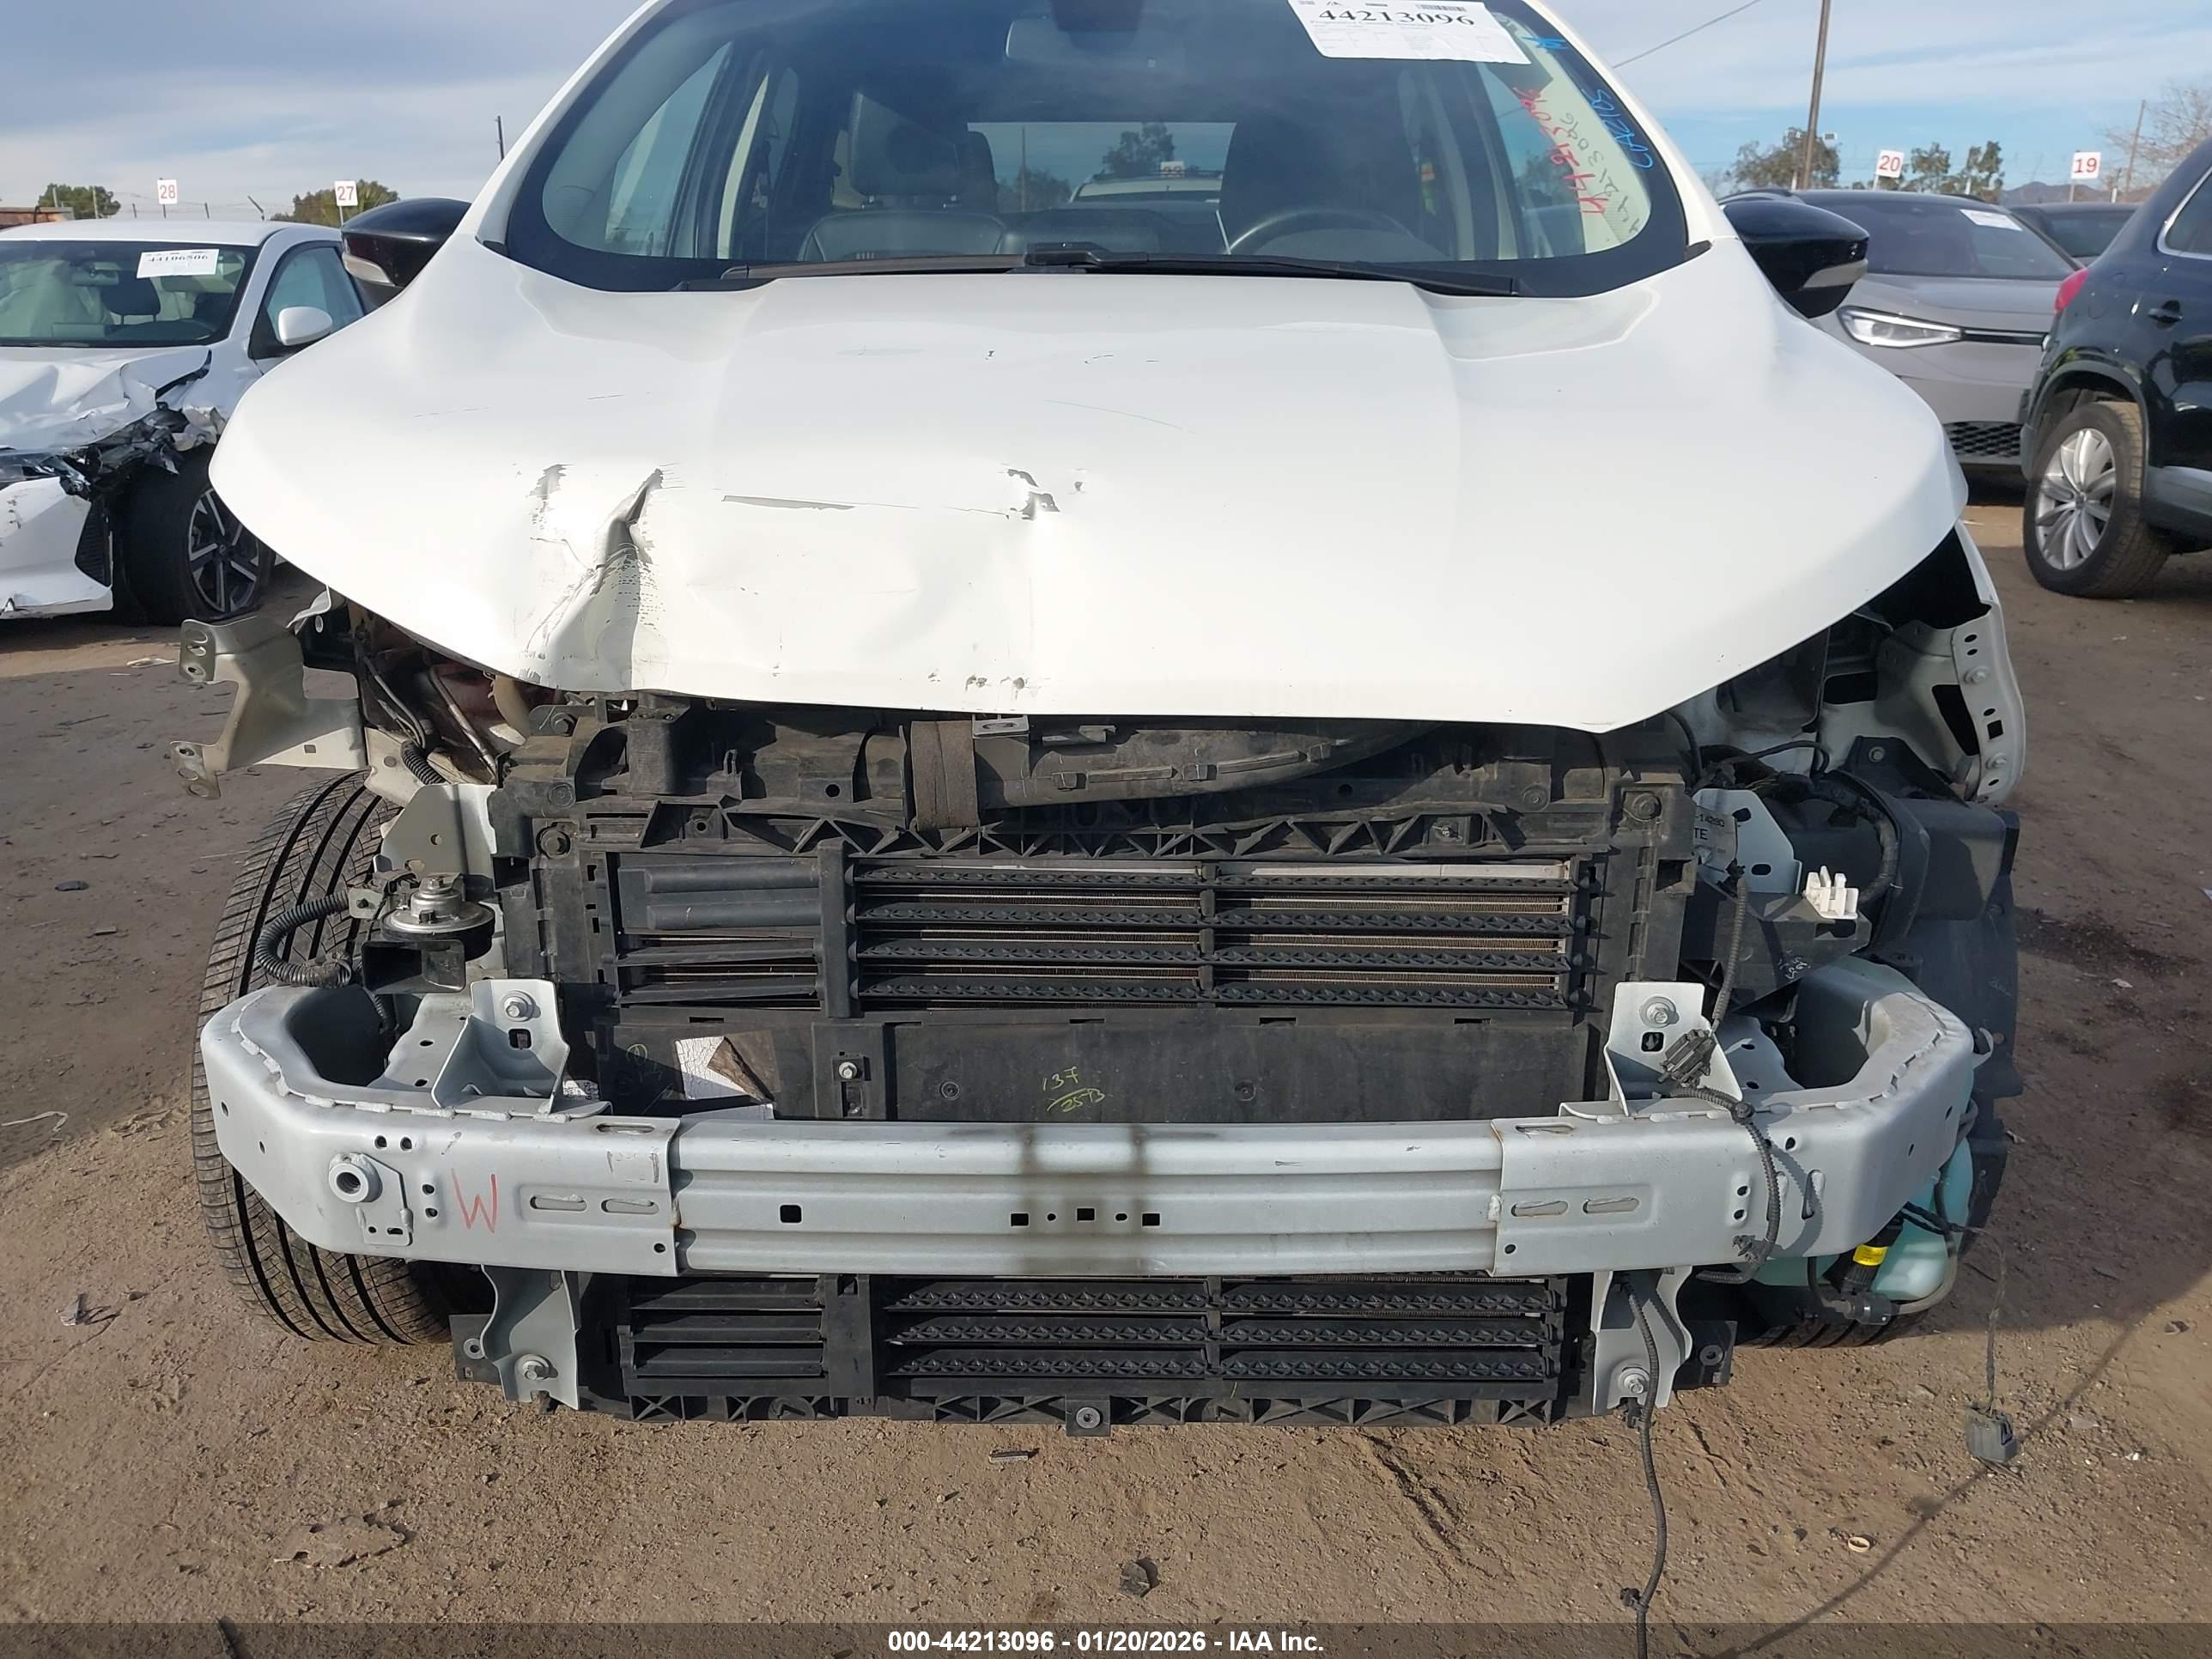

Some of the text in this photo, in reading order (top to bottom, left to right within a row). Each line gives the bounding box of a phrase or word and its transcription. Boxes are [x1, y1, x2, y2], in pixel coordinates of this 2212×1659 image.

[1318, 10, 1475, 27] 44213096
[1879, 155, 1901, 173] 20
[2074, 157, 2097, 173] 19
[160, 185, 176, 199] 28
[337, 185, 355, 201] 27
[453, 1172, 497, 1233] W
